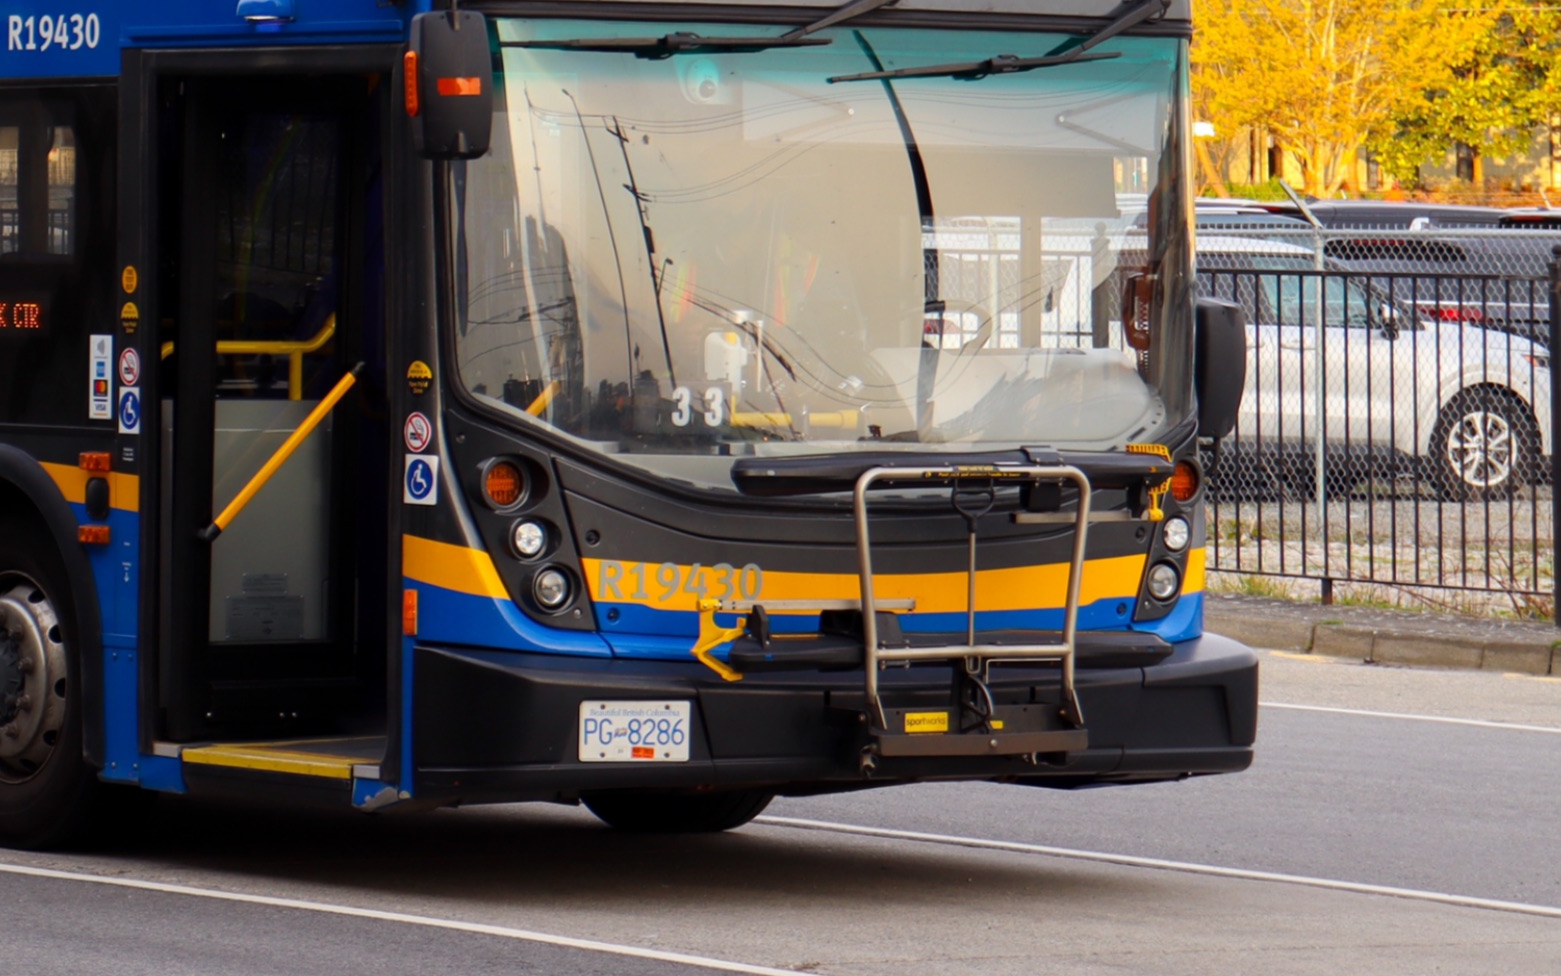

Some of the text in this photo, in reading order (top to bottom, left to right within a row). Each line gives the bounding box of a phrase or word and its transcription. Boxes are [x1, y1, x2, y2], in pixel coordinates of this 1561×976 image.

[8, 12, 100, 52] R19430
[13, 303, 39, 329] CTR
[597, 559, 763, 602] R19430
[589, 708, 680, 717] Beautiful British Columbia
[906, 716, 946, 727] sportworks
